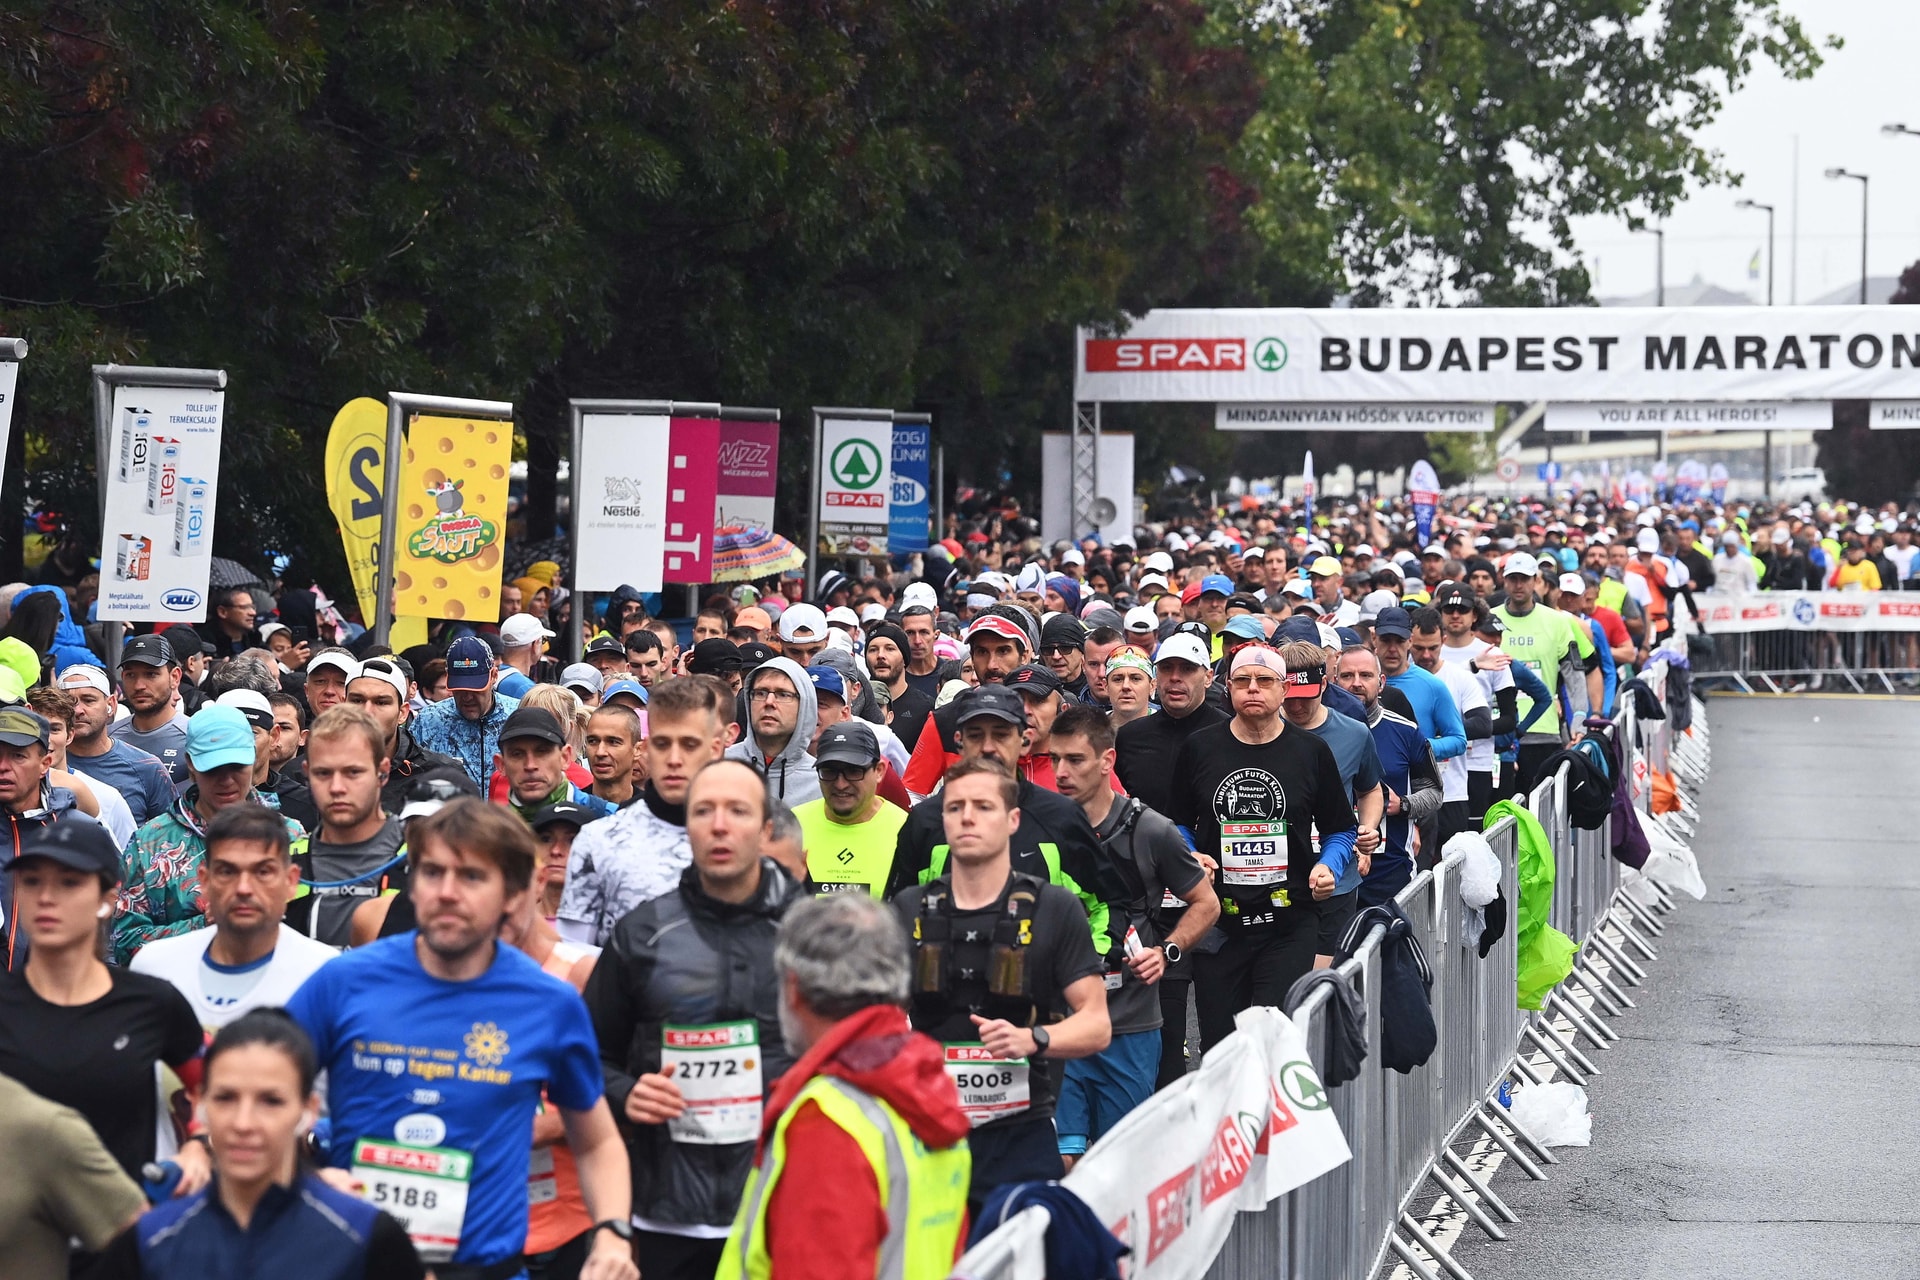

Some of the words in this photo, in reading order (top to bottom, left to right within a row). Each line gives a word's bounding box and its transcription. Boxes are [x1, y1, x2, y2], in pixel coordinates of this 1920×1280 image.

[1116, 343, 1243, 367] SPAR
[1320, 336, 1619, 372] BUDAPEST
[1644, 333, 1920, 370] MARATON
[185, 403, 203, 412] TOLLE
[205, 404, 218, 412] UHT
[169, 415, 217, 424] TERMÉKCSALÁD
[1226, 408, 1343, 423] MINDANNYIAN
[1404, 408, 1484, 424] VAGYTOK!
[1600, 408, 1631, 423] YOU
[1636, 408, 1667, 423] ARE
[1673, 408, 1702, 423] ALL
[1707, 408, 1777, 423] HEROES!
[723, 469, 769, 477] wizzair.com
[827, 494, 883, 506] SPAR
[603, 505, 641, 517] Nestlé
[165, 595, 196, 605] TOLLE
[1509, 636, 1534, 646] ROB
[1216, 772, 1244, 805] JUBILEUMI
[1244, 770, 1271, 782] FUTÓK
[1269, 780, 1283, 809] KLUBJA
[1232, 824, 1269, 833] SPAR
[1225, 845, 1231, 853] 3
[1235, 842, 1273, 855] 1445
[1245, 858, 1264, 866] TAMÁS
[673, 1030, 730, 1045] SPAR
[957, 1049, 993, 1059] SPA
[679, 1059, 737, 1079] 2772
[957, 1071, 1013, 1088] 5008
[374, 1149, 439, 1172] SPAR
[374, 1182, 438, 1210] 5188
